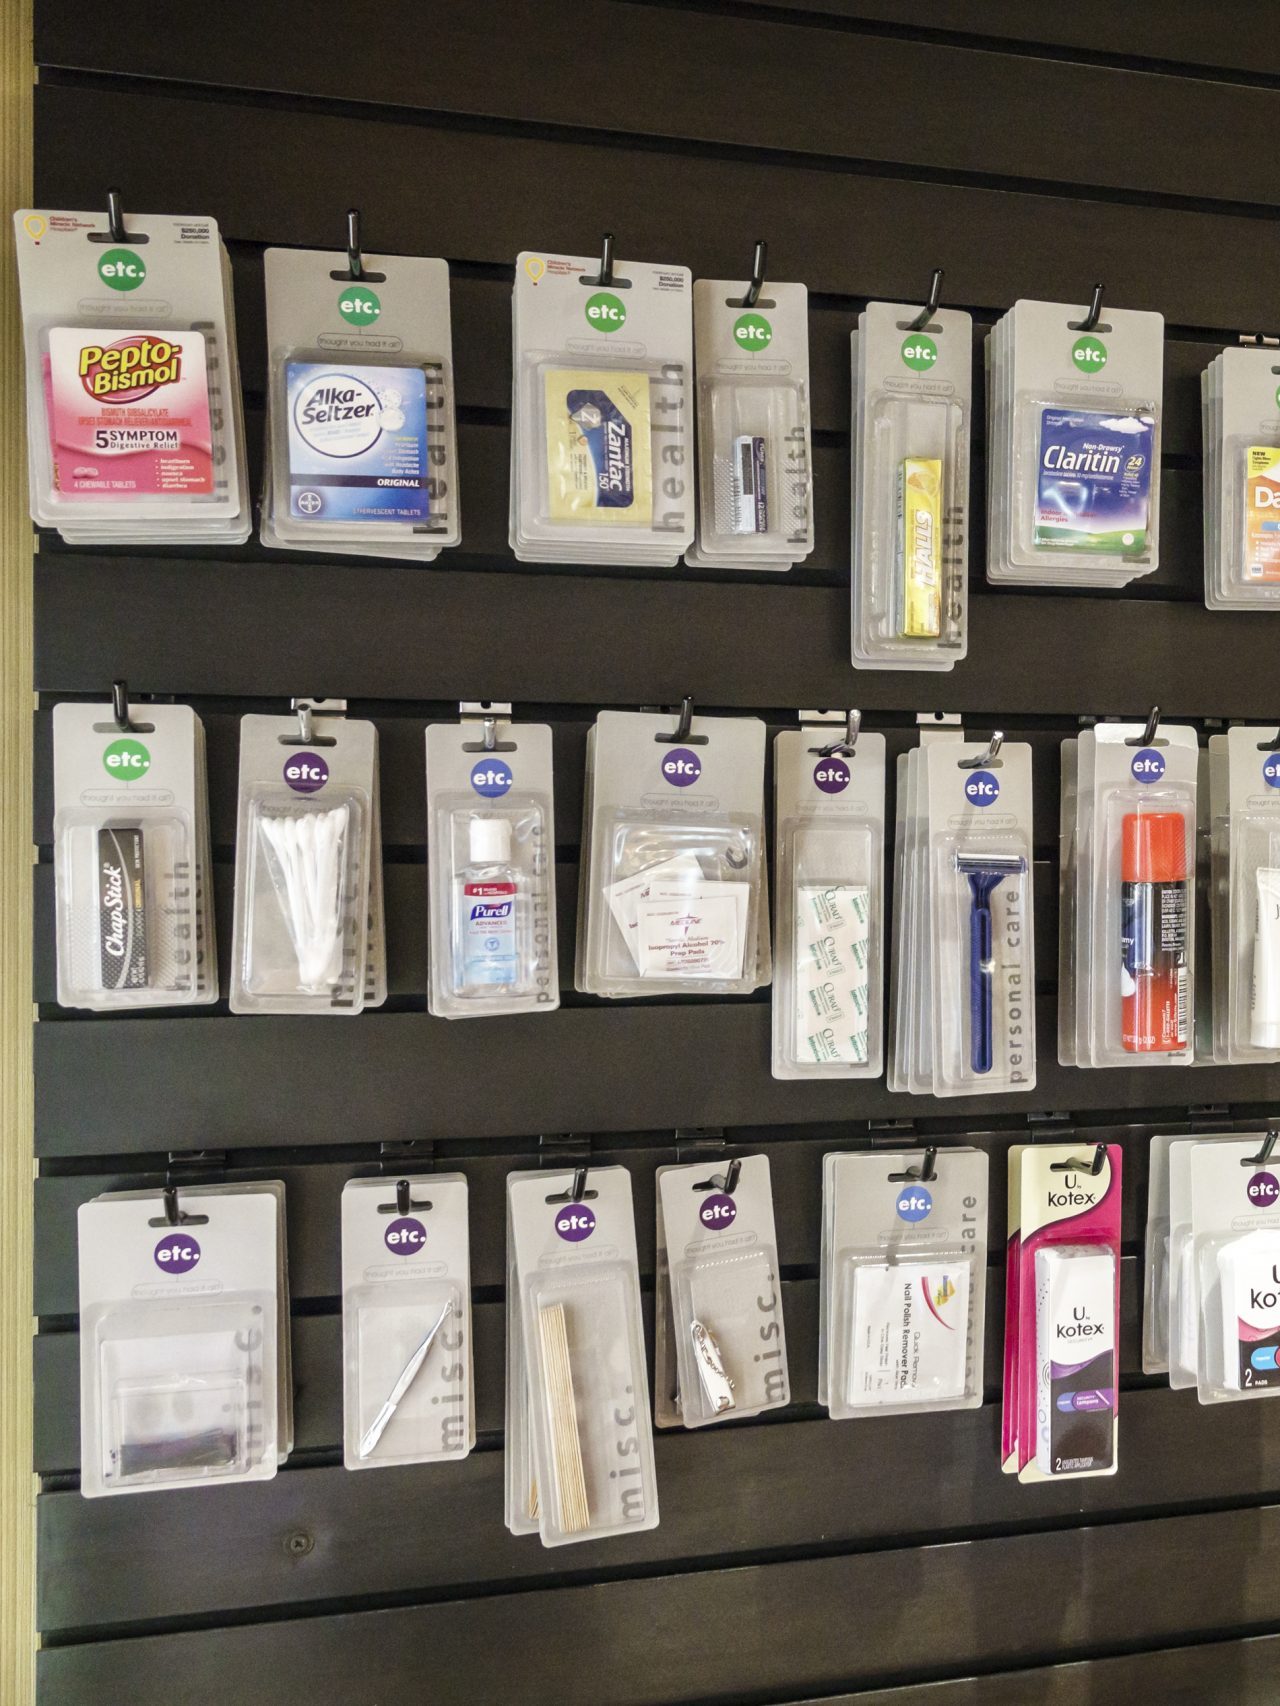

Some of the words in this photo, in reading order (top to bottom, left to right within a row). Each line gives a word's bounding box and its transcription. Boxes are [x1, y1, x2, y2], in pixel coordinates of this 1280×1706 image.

[100, 261, 146, 278] etc.
[340, 298, 381, 315] etc.
[587, 304, 626, 321] etc.
[735, 326, 772, 341] etc.
[79, 340, 181, 376] Pepto-
[903, 344, 938, 361] etc.
[1073, 346, 1107, 363] etc.
[93, 357, 181, 394] Bismol
[307, 388, 362, 406] Alka-
[302, 402, 375, 425] Seltzer
[96, 430, 109, 449] 5
[110, 430, 178, 441] SYMPTOM
[110, 442, 150, 450] Digestive
[652, 363, 685, 533] health
[607, 421, 626, 492] Zantac
[1043, 445, 1121, 474] Claritin
[1128, 456, 1143, 466] 24
[79, 481, 111, 489] CHEWABLE
[112, 481, 137, 489] TABLETS
[377, 478, 420, 488] ORIGINAL
[598, 472, 609, 490] 150
[784, 426, 808, 543] health
[397, 508, 421, 516] TABLETS
[1040, 515, 1068, 523] Allergies
[913, 509, 933, 589] HALLS
[106, 751, 150, 768] etc.
[1132, 758, 1165, 774] etc.
[286, 764, 328, 781] etc.
[663, 760, 702, 777] etc.
[815, 767, 850, 783] etc.
[473, 769, 513, 787] etc.
[966, 781, 1000, 797] etc.
[134, 880, 143, 909] ORIGINAL
[472, 888, 483, 896] #1
[102, 863, 127, 958] ChapStick
[475, 905, 509, 917] Purell
[1006, 890, 1020, 947] care
[682, 941, 709, 949] Alcohol
[1001, 962, 1028, 1085] personal
[1065, 1174, 1077, 1190] U
[1248, 1181, 1280, 1198] etc.
[898, 1196, 932, 1212] etc.
[1048, 1191, 1095, 1208] kotex
[701, 1202, 737, 1222] etc.
[557, 1214, 596, 1232] etc.
[960, 1195, 977, 1253] care
[387, 1229, 427, 1244] etc.
[157, 1245, 201, 1262] etc.
[904, 1283, 912, 1301] Nail
[903, 1302, 912, 1327] Polish
[1073, 1306, 1086, 1321] U
[753, 1273, 785, 1401] misc.
[1056, 1323, 1104, 1339] kotex
[902, 1329, 910, 1369] Remover
[913, 1331, 921, 1354] Quick
[222, 1306, 263, 1466] misc.
[432, 1309, 464, 1453] misc.
[1244, 1368, 1253, 1387] 2
[609, 1384, 644, 1521] misc.
[1055, 1457, 1062, 1471] 2
